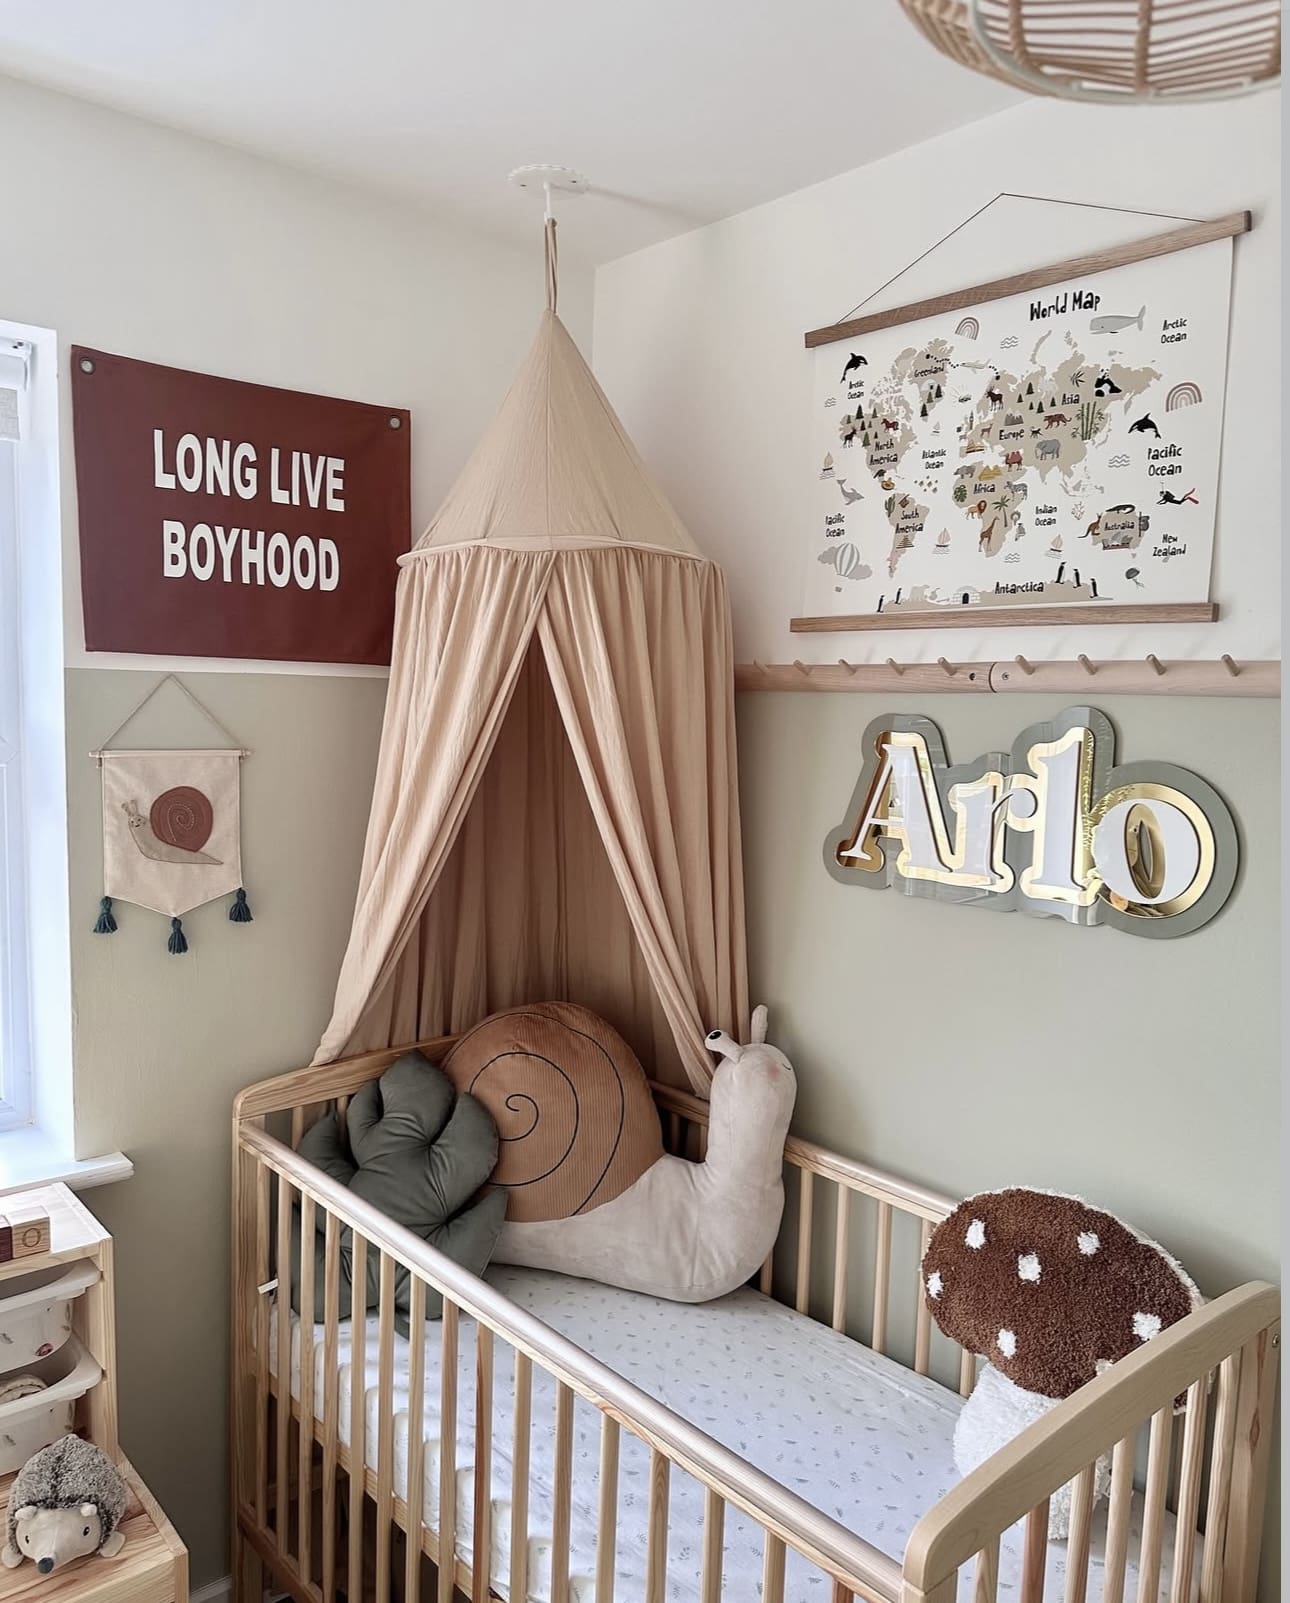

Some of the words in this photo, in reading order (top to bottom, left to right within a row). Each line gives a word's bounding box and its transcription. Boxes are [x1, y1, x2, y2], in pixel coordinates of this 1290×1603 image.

[1030, 293, 1067, 321] World
[1072, 291, 1101, 312] Map
[1162, 318, 1187, 331] Arctic
[1161, 332, 1186, 344] Ocean
[914, 365, 945, 377] Greenland
[848, 380, 864, 389] Arctic
[847, 391, 864, 400] Ocean
[1061, 393, 1080, 405] Asia
[999, 428, 1024, 440] Europe
[874, 440, 894, 451] North
[922, 449, 947, 460] Atlantic
[1147, 445, 1182, 460] Pacific
[869, 453, 898, 465] America
[925, 461, 944, 469] Ocean
[153, 429, 258, 500] LONG
[270, 447, 345, 512] LIVE
[1148, 463, 1182, 476] Ocean
[973, 483, 995, 494] Africa
[900, 510, 919, 520] South
[1035, 504, 1057, 515] Indian
[1035, 517, 1056, 526] Ocean
[1104, 520, 1134, 531] Australia
[825, 527, 845, 538] Ocean
[896, 522, 924, 534] America
[1162, 534, 1178, 544] New
[163, 520, 340, 592] BOYHOOD
[1153, 544, 1186, 557] Zealand
[995, 582, 1044, 595] Antarctica
[835, 725, 1215, 919] Arlo
